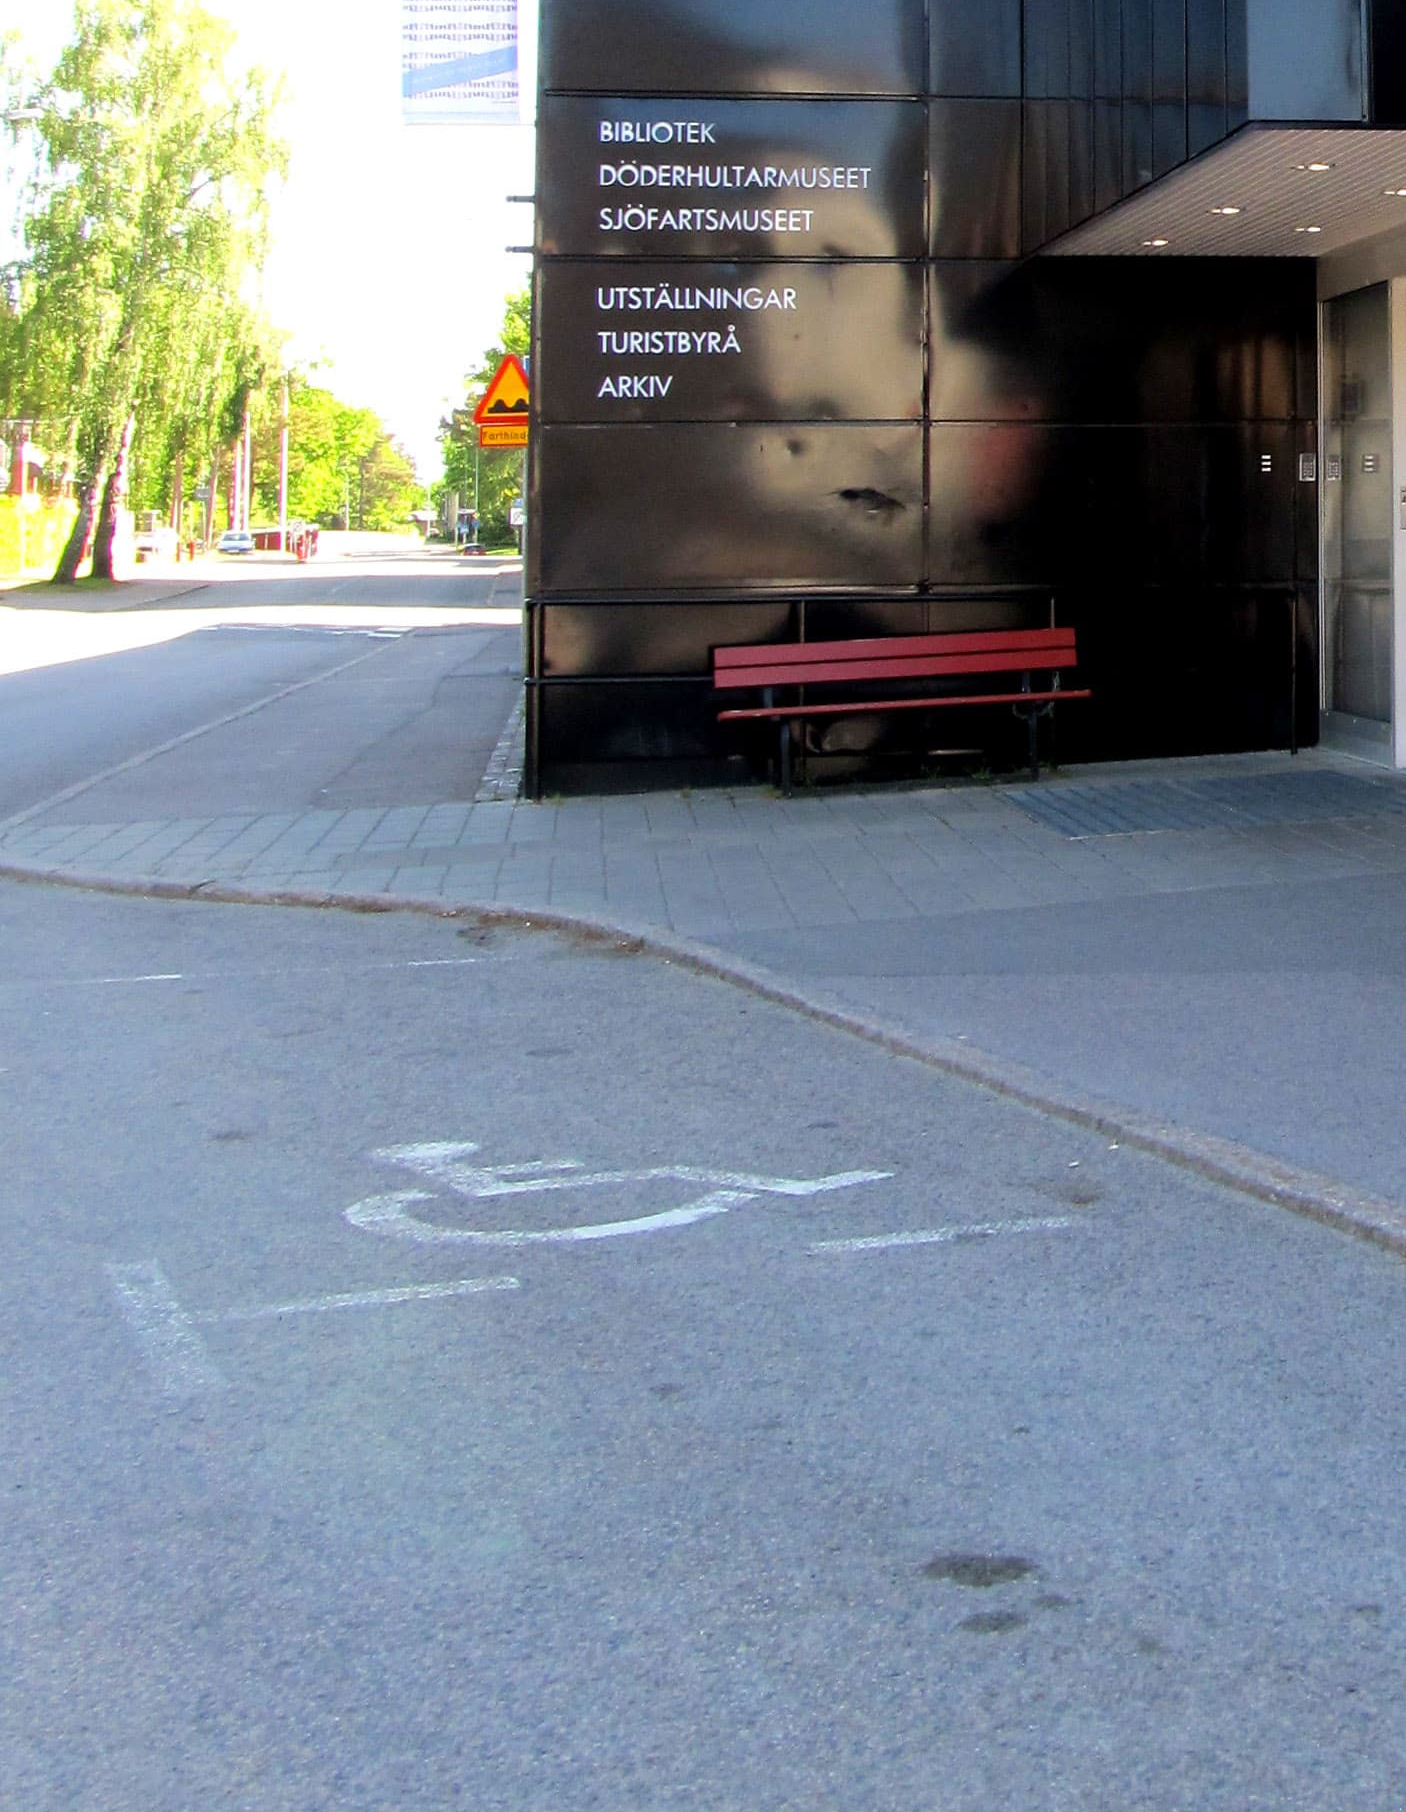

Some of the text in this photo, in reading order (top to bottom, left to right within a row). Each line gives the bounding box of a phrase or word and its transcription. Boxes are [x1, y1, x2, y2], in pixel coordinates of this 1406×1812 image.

[599, 122, 716, 143] BIBLIOTEK
[599, 160, 871, 189] DÖDERHULTARMUSEET
[599, 204, 813, 231] SJÖFARTSMUSEET
[598, 283, 796, 309] UTSTÄLLNINGAR
[597, 325, 741, 354] TURISTBYRÅ
[598, 376, 672, 397] ARKIV
